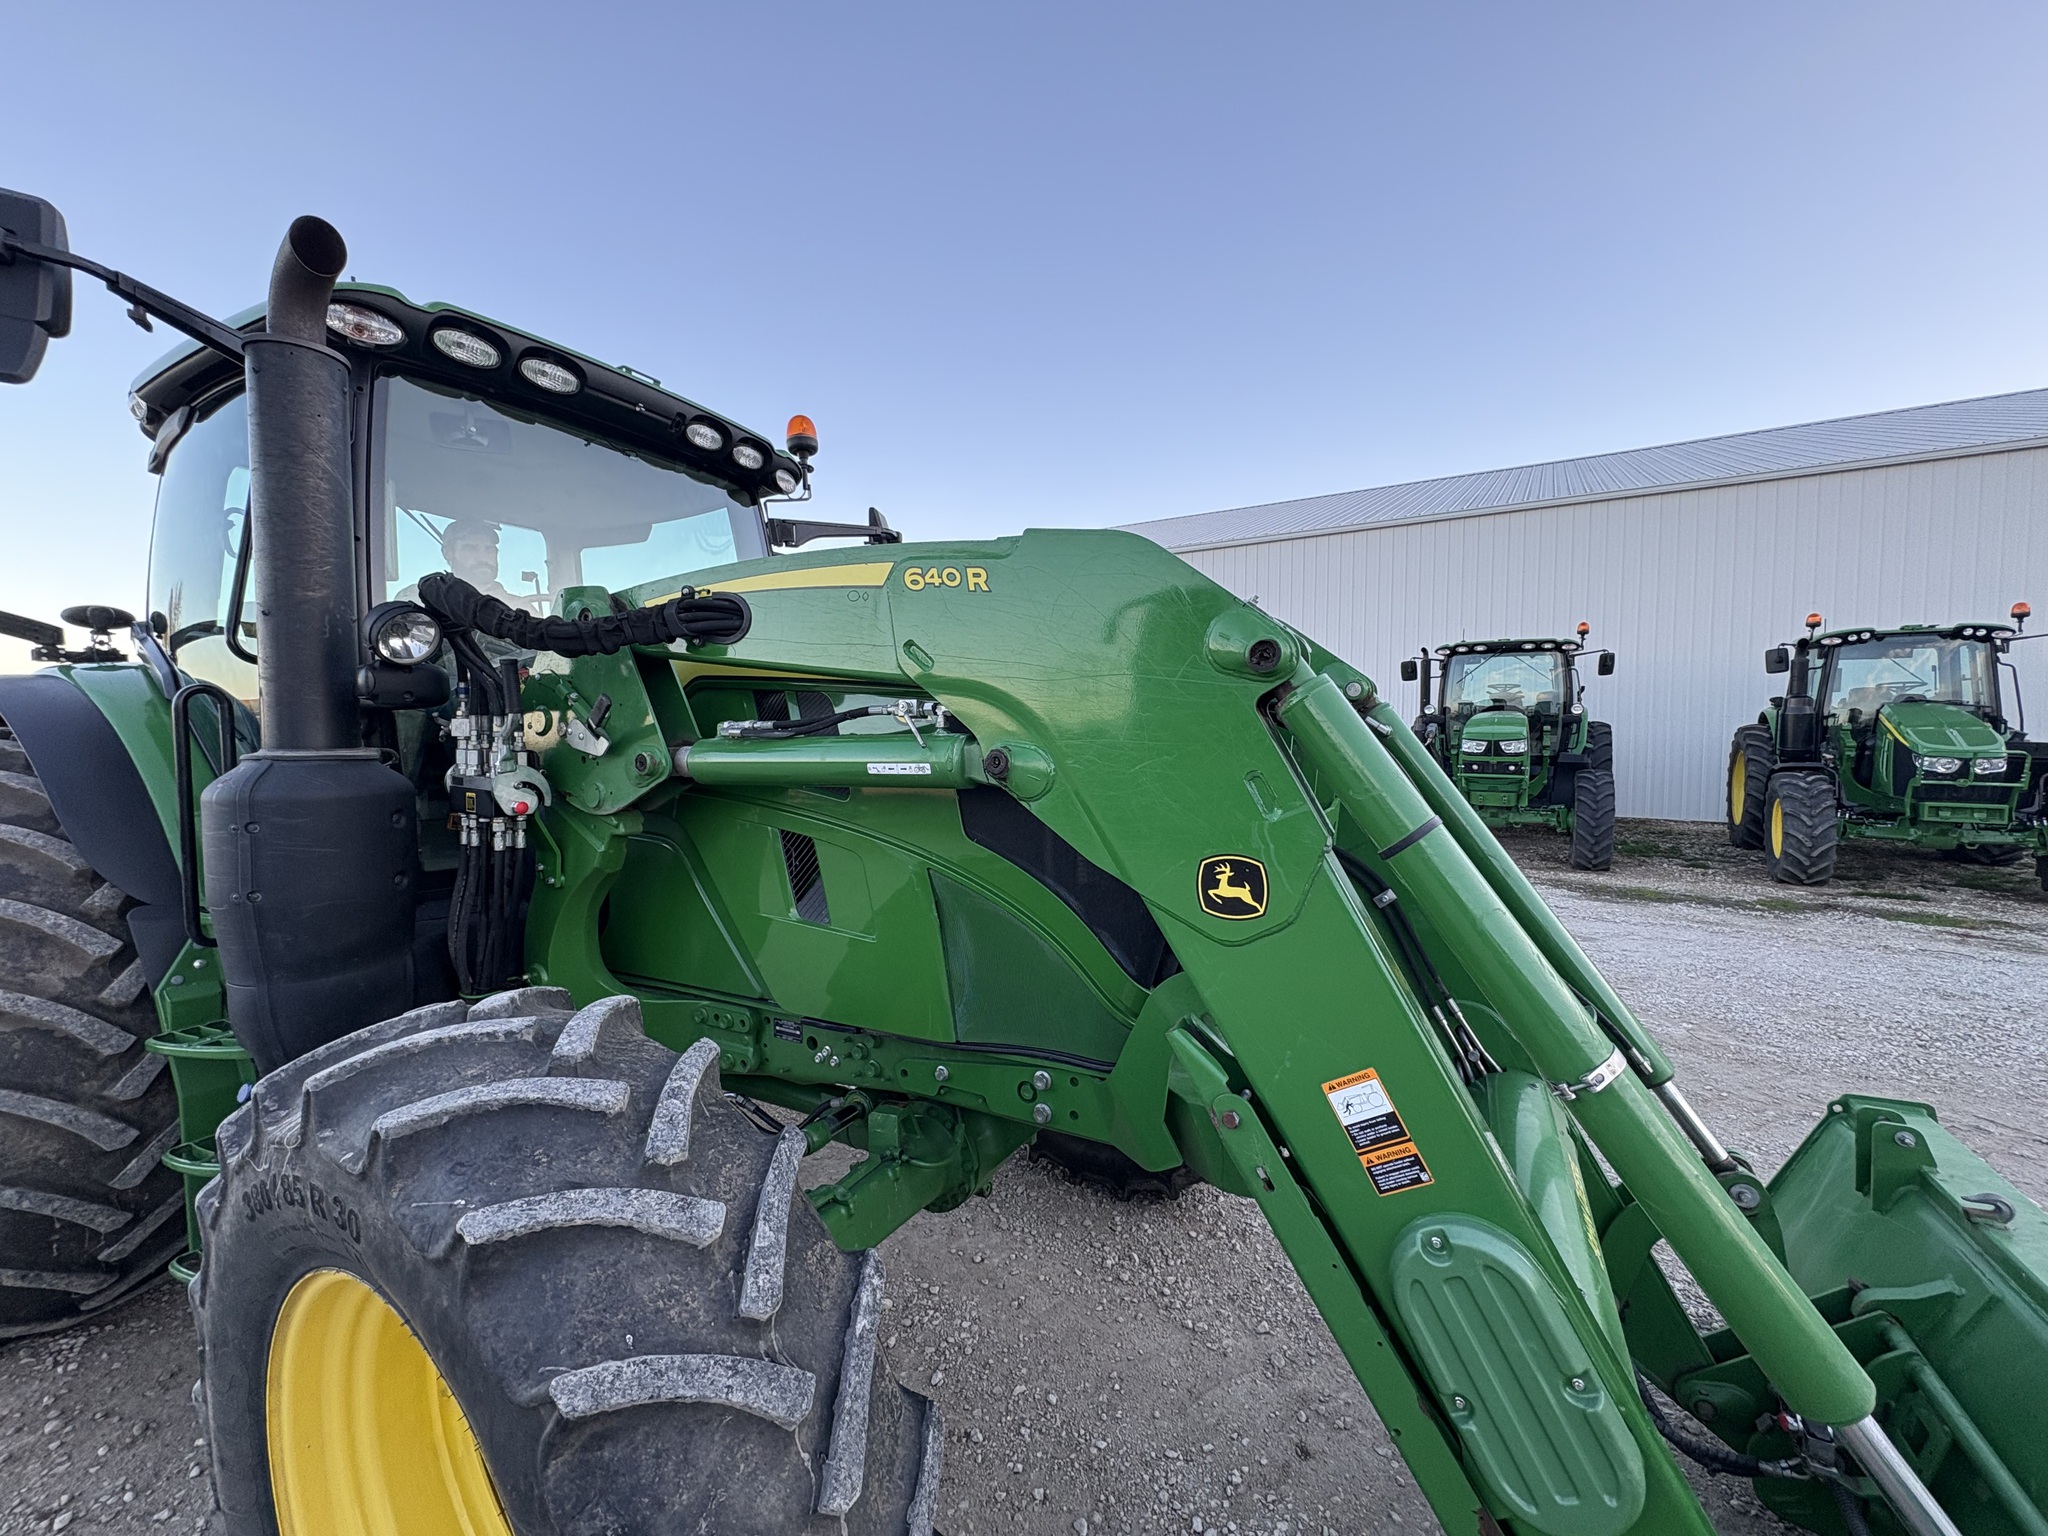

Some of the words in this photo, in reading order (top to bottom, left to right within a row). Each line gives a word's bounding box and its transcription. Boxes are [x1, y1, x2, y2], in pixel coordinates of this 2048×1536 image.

[903, 566, 962, 592] 640
[965, 566, 992, 593] R
[1335, 1072, 1371, 1088] WARNING
[1375, 1146, 1412, 1161] WARNING
[242, 1172, 306, 1222] 380/85
